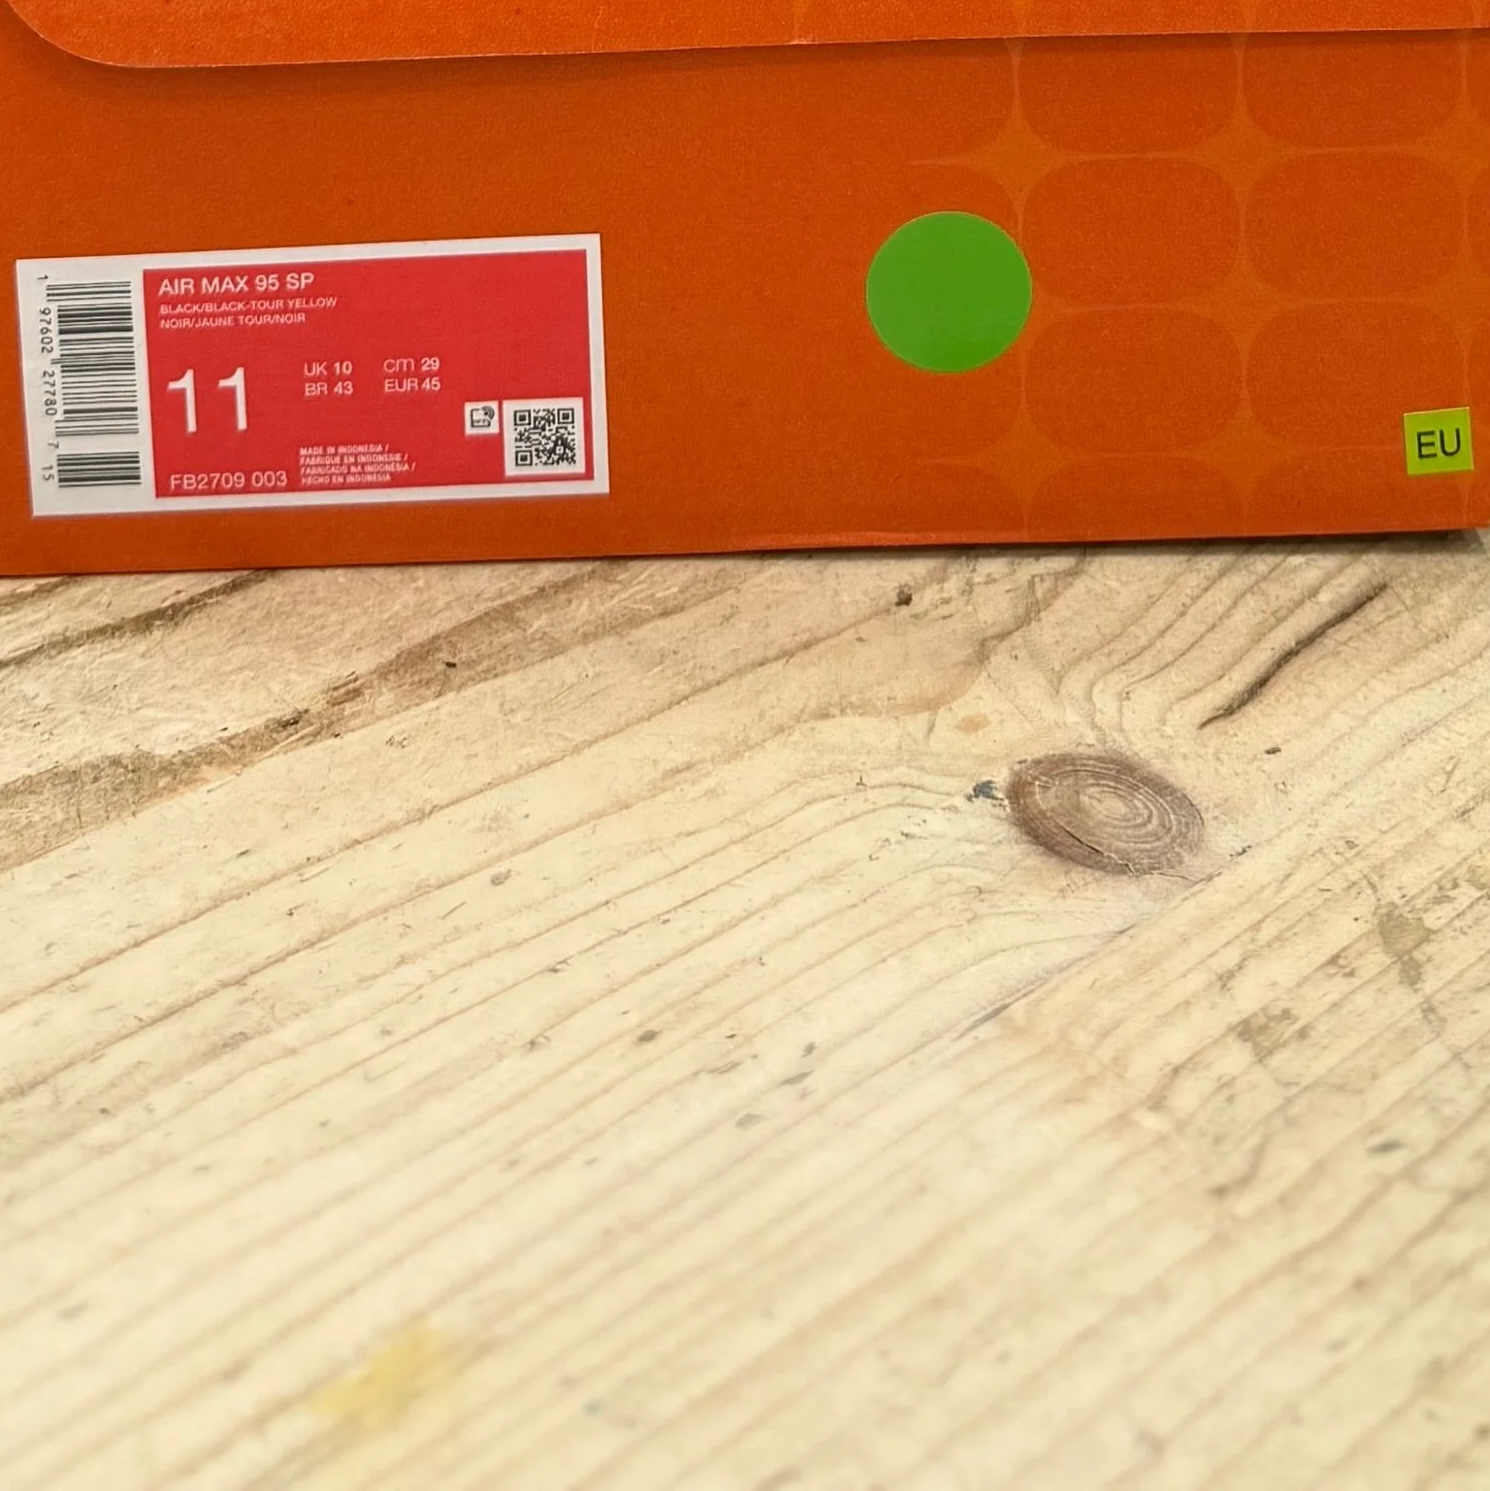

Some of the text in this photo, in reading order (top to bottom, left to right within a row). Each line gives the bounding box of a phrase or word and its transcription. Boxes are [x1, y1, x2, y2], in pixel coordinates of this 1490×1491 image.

[158, 272, 315, 296] AIR MAX 95 SP
[160, 297, 338, 315] BLACK/BLACK-TOUR YELLOW
[160, 313, 306, 329] NOIR/JAUNE TOUR/NOIR
[39, 307, 54, 354] 97602
[304, 361, 353, 377] UK 10
[420, 357, 440, 371] 29
[43, 370, 58, 416] 27780
[304, 380, 354, 396] BR 43
[383, 377, 441, 393] EUR 45
[167, 367, 248, 433] 11
[300, 446, 324, 456] MADE
[326, 446, 336, 454] IN
[1417, 428, 1461, 459] EU
[343, 455, 355, 464] EN
[170, 470, 287, 490] FB2709 003
[301, 475, 330, 484] HECHO
[332, 474, 344, 483] EN
